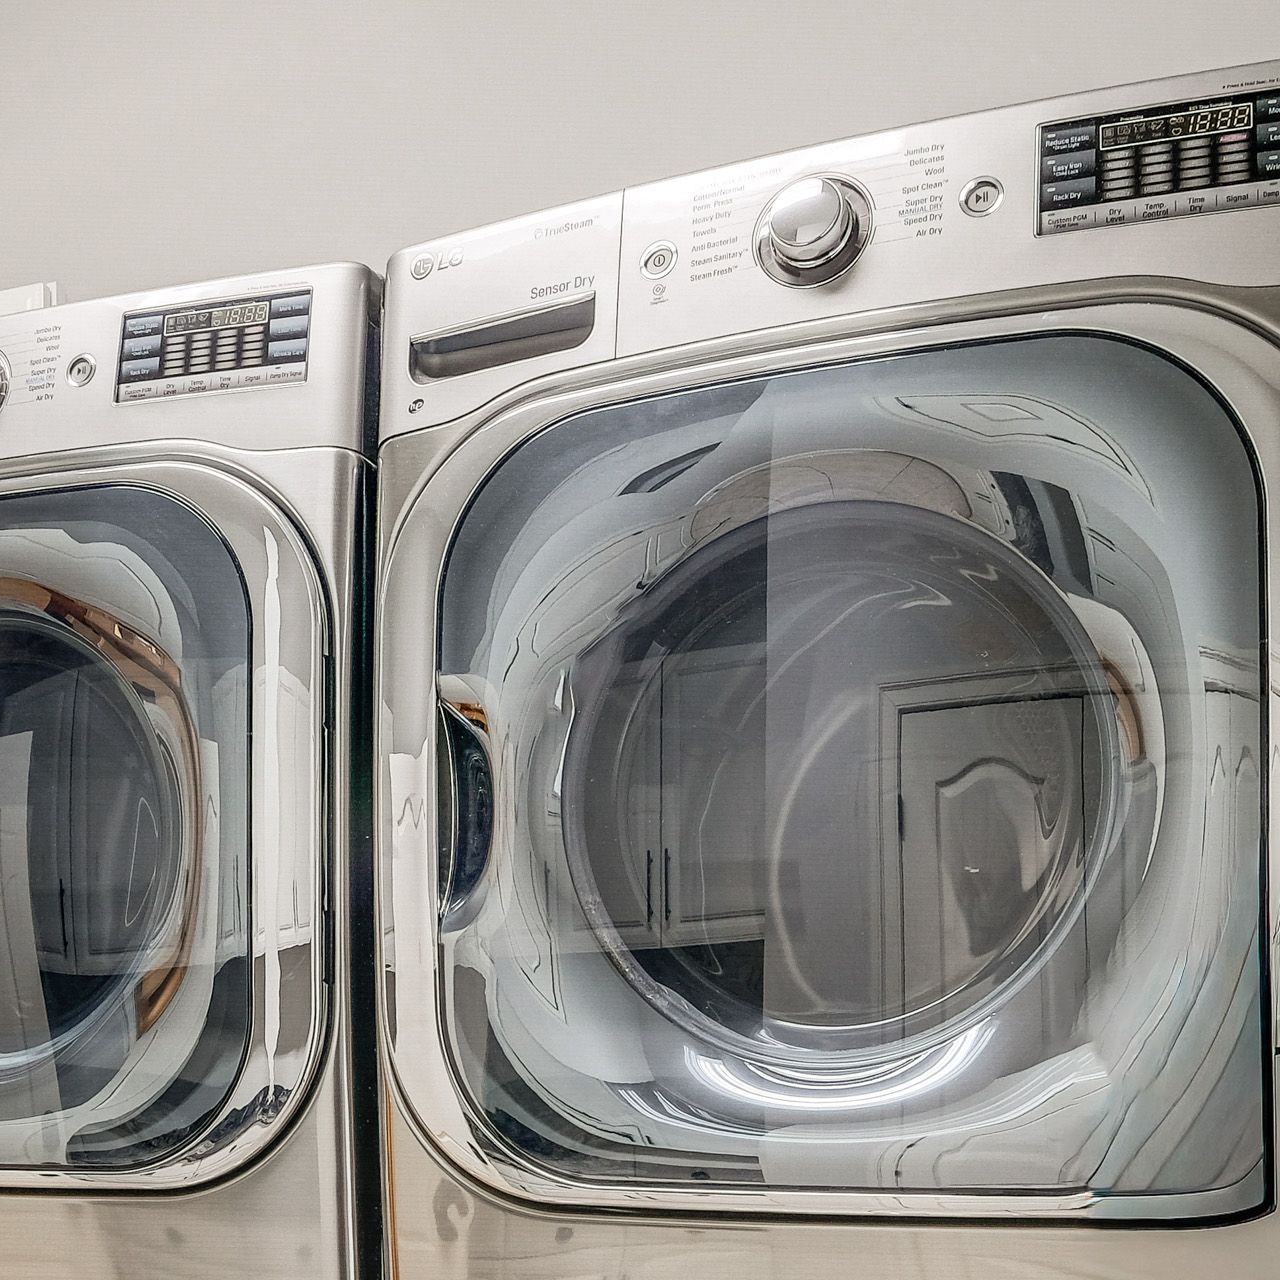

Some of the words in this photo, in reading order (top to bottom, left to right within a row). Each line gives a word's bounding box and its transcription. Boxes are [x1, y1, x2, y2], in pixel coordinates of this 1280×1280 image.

[1045, 138, 1069, 147] Reduce
[1070, 135, 1089, 143] Static
[904, 146, 930, 157] Jumbo
[931, 144, 945, 152] Dry
[909, 155, 945, 167] Delicates
[1052, 163, 1069, 173] Easy
[1069, 161, 1082, 169] Iron
[925, 166, 945, 176] Wool
[902, 185, 919, 195] Spot
[921, 181, 943, 191] Clean
[1263, 190, 1280, 198] Damp
[905, 198, 928, 208] Super
[930, 194, 943, 203] Dry
[1053, 193, 1069, 201] Rack
[1070, 191, 1082, 200] Dry
[1188, 196, 1205, 204] Time
[1226, 193, 1249, 203] Signal
[898, 206, 927, 217] MANUAL
[929, 203, 943, 211] DRY
[1109, 208, 1122, 217] Dry
[1142, 208, 1169, 218] Control
[1189, 204, 1203, 212] Dry
[691, 215, 714, 225] Heavy
[715, 210, 732, 220] Duty
[903, 215, 928, 226] Speed
[930, 213, 943, 222] Dry
[1047, 216, 1072, 225] Custom
[1072, 214, 1087, 222] PGM
[1105, 215, 1125, 224] Level
[692, 227, 717, 238] Towels
[916, 229, 927, 237] Air
[929, 227, 943, 236] Dry
[691, 243, 706, 253] Anti
[706, 236, 738, 250] Bacterial
[690, 256, 713, 267] Steam
[713, 250, 743, 263] Sanitary
[690, 271, 712, 282] Steam
[713, 266, 733, 277] Fresh
[530, 279, 571, 299] Sensor
[574, 275, 596, 290] Dry
